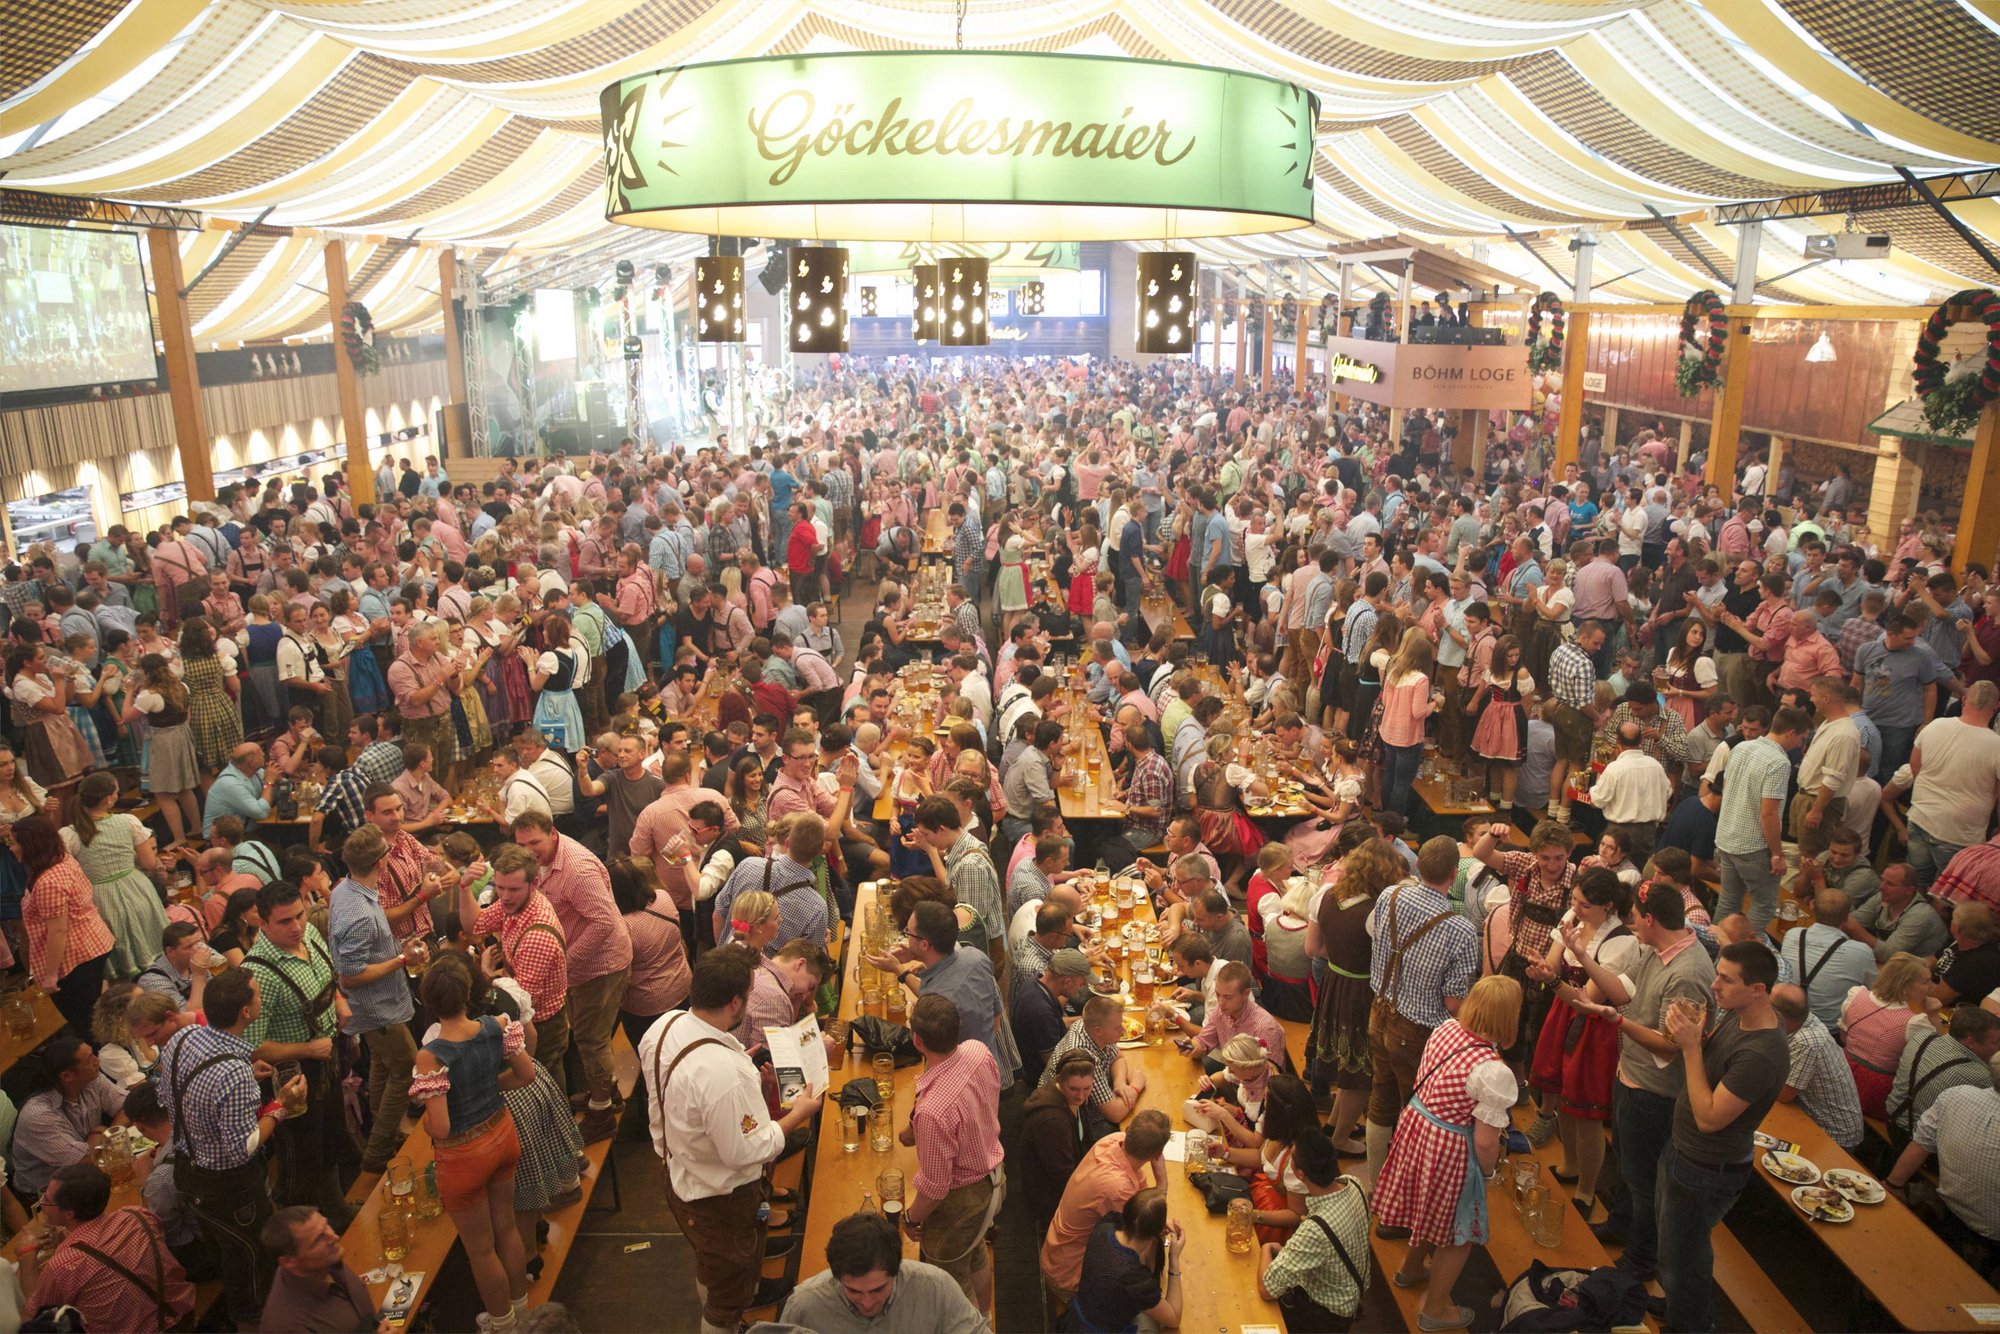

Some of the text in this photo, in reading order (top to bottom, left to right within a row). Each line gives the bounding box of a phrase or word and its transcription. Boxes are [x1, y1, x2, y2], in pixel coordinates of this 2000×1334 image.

[748, 89, 1196, 186] Göckelesmaier
[1413, 364, 1515, 381] BÖHM LOGE
[1585, 377, 1603, 389] LOGE
[1577, 792, 1592, 804] RIL
